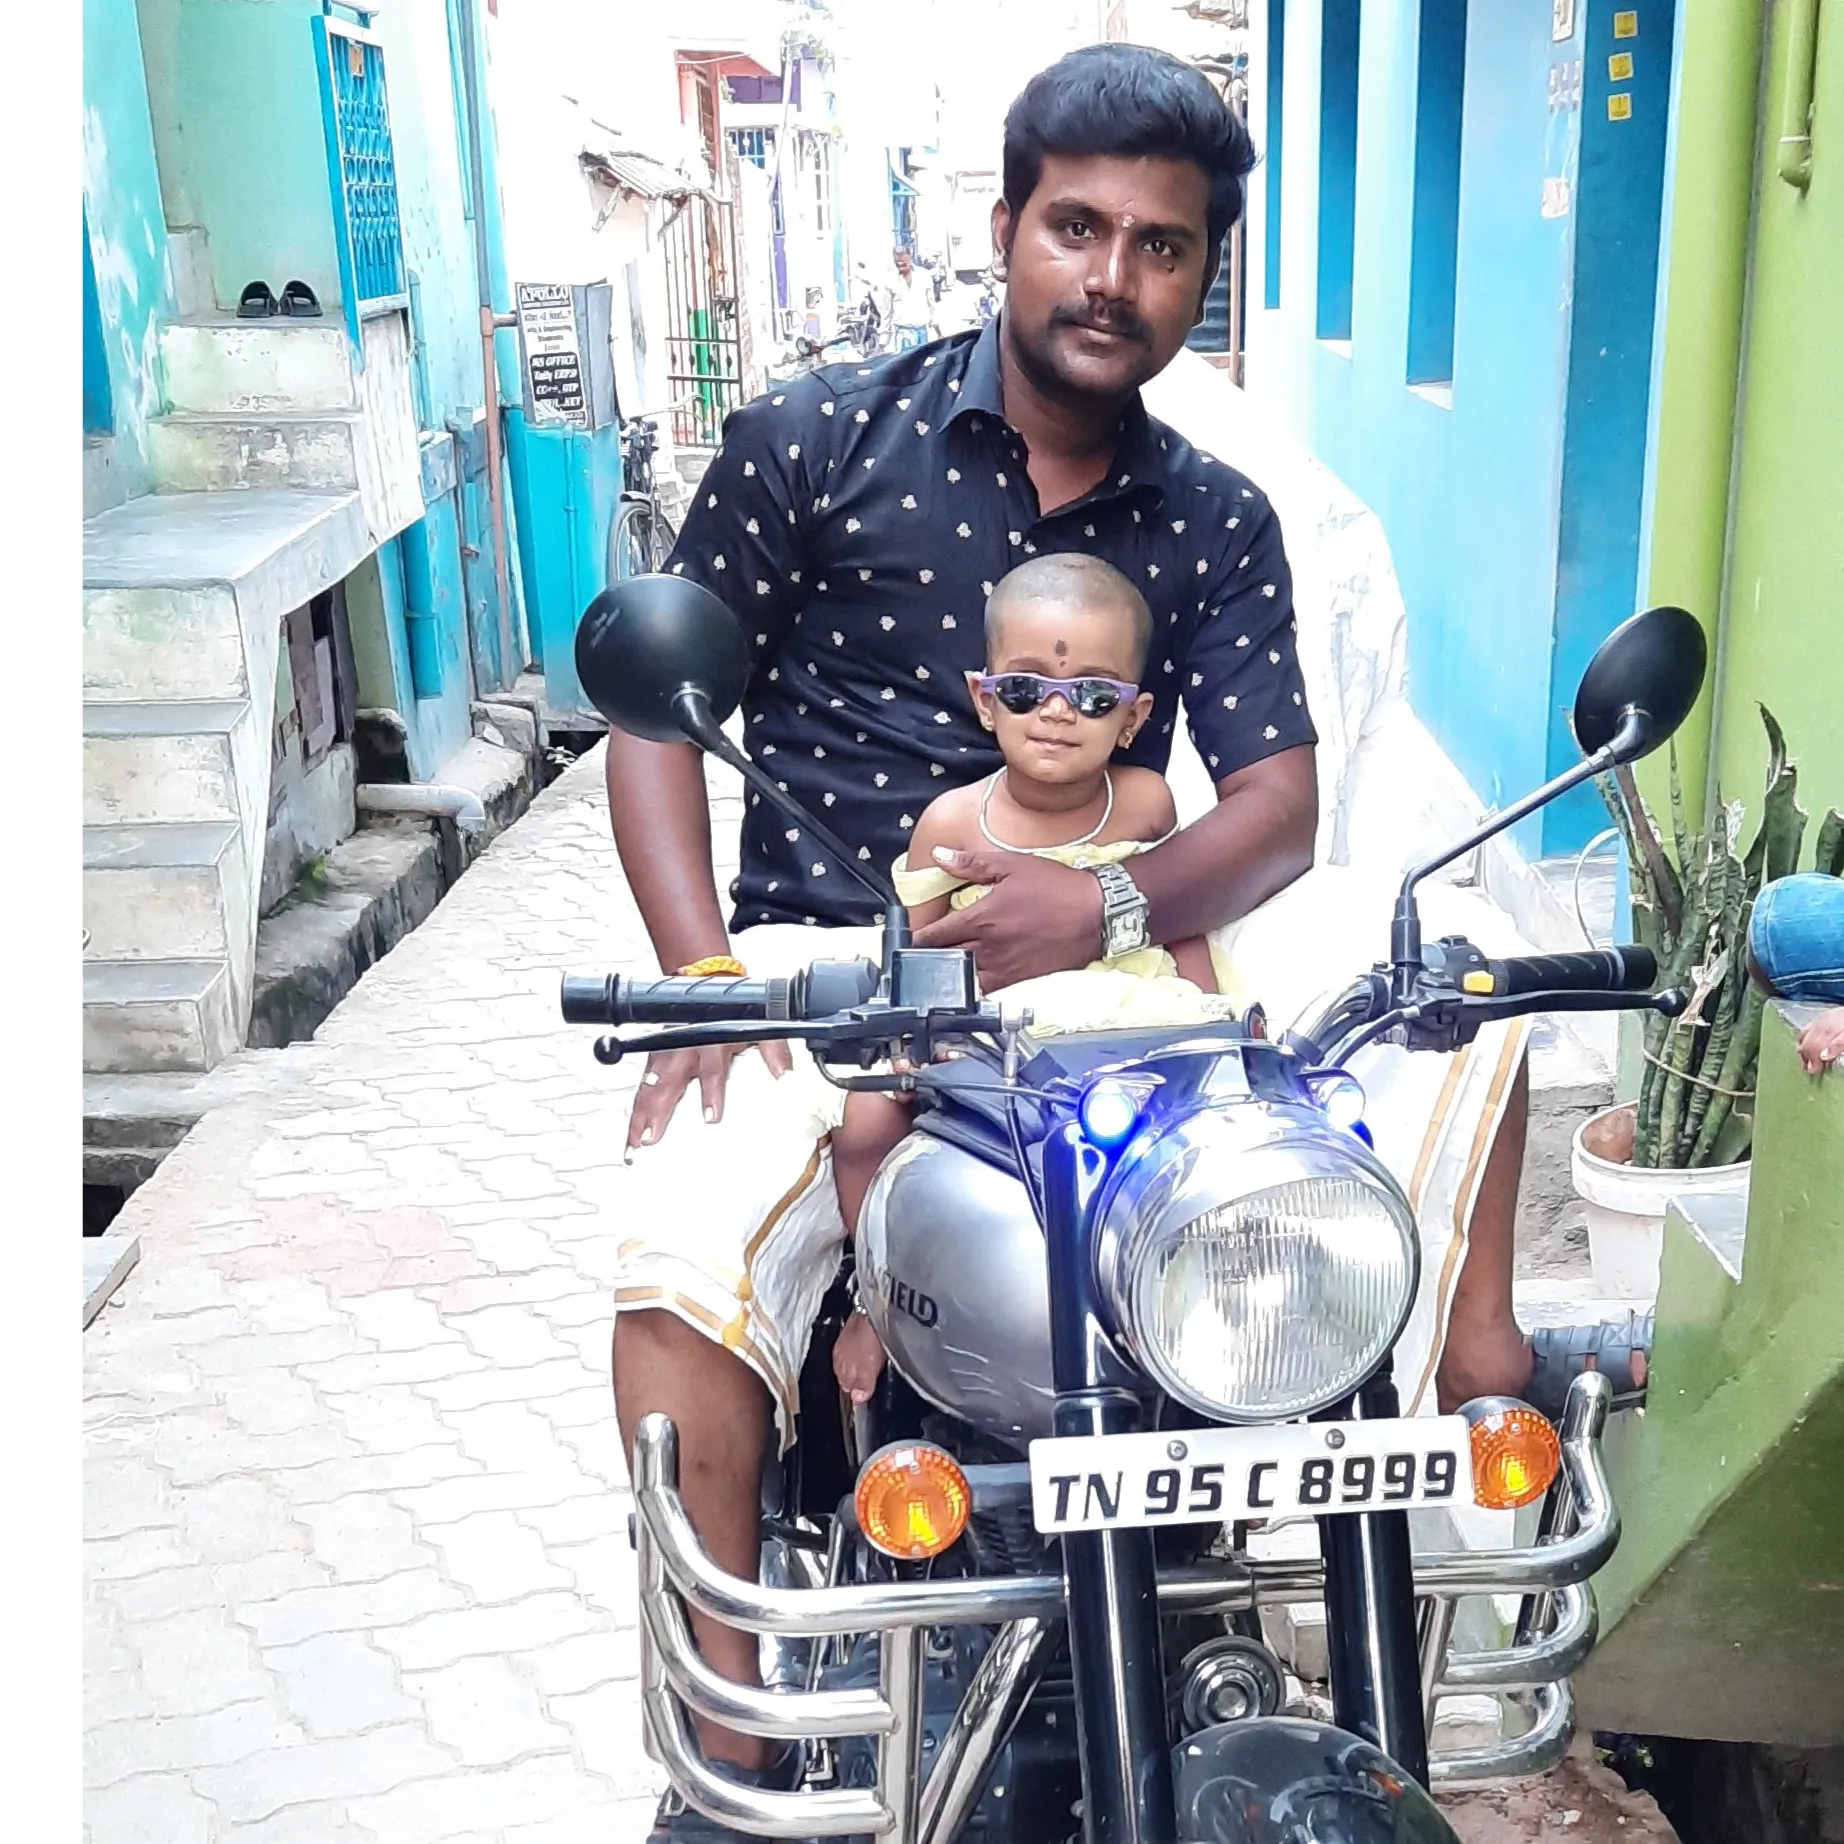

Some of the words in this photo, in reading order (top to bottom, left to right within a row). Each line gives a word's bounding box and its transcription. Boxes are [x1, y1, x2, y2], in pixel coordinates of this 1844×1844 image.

[522, 285, 569, 301] APOLLO
[546, 355, 576, 366] OFFICE
[1049, 1470, 1124, 1523] TN
[1143, 1464, 1225, 1517] 95
[1246, 1460, 1279, 1510] C
[1298, 1449, 1458, 1506] 8999
